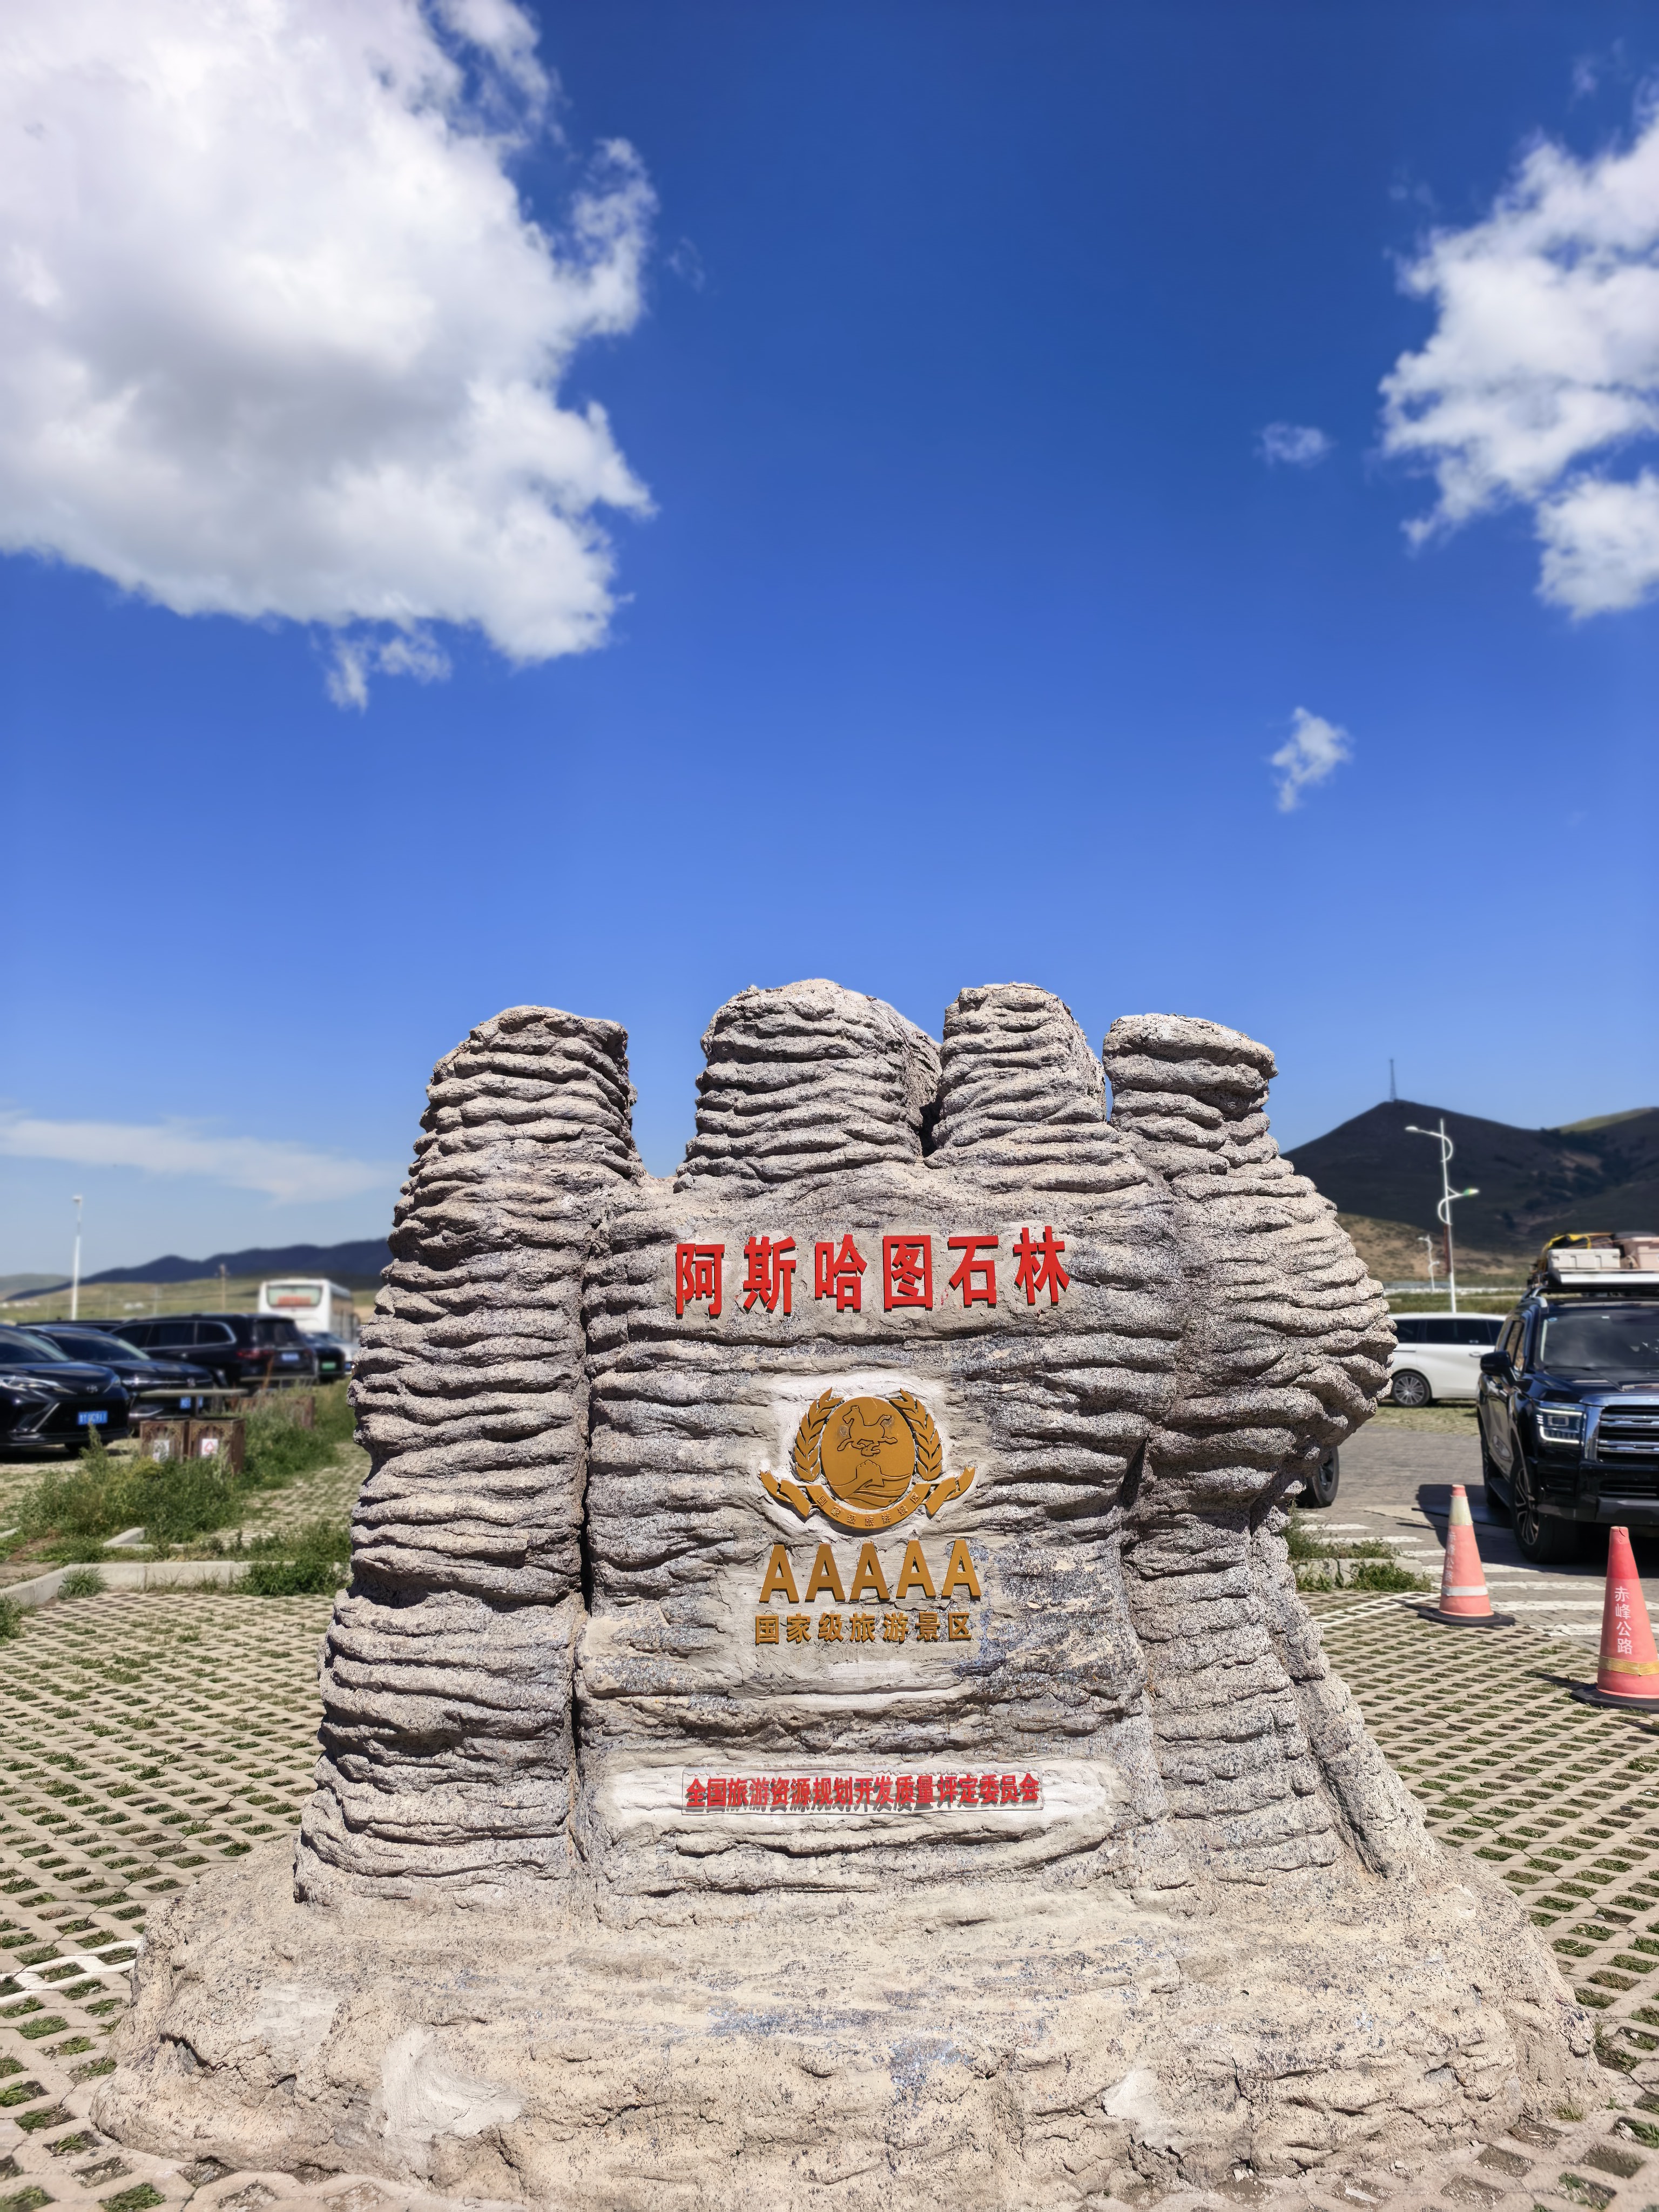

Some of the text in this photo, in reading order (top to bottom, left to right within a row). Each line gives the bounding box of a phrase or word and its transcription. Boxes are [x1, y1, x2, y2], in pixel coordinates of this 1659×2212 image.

[676, 1225, 1070, 1316] 阿斯哈图石林
[817, 1492, 920, 1527] 国家级旅游景区
[759, 1539, 981, 1603] AAAAA
[756, 1611, 972, 1644] 国家级旅游景区
[1615, 1586, 1633, 1655] 赤峰公路
[686, 1773, 1039, 1806] 全国旅游资源规划开发质量评定委员会
